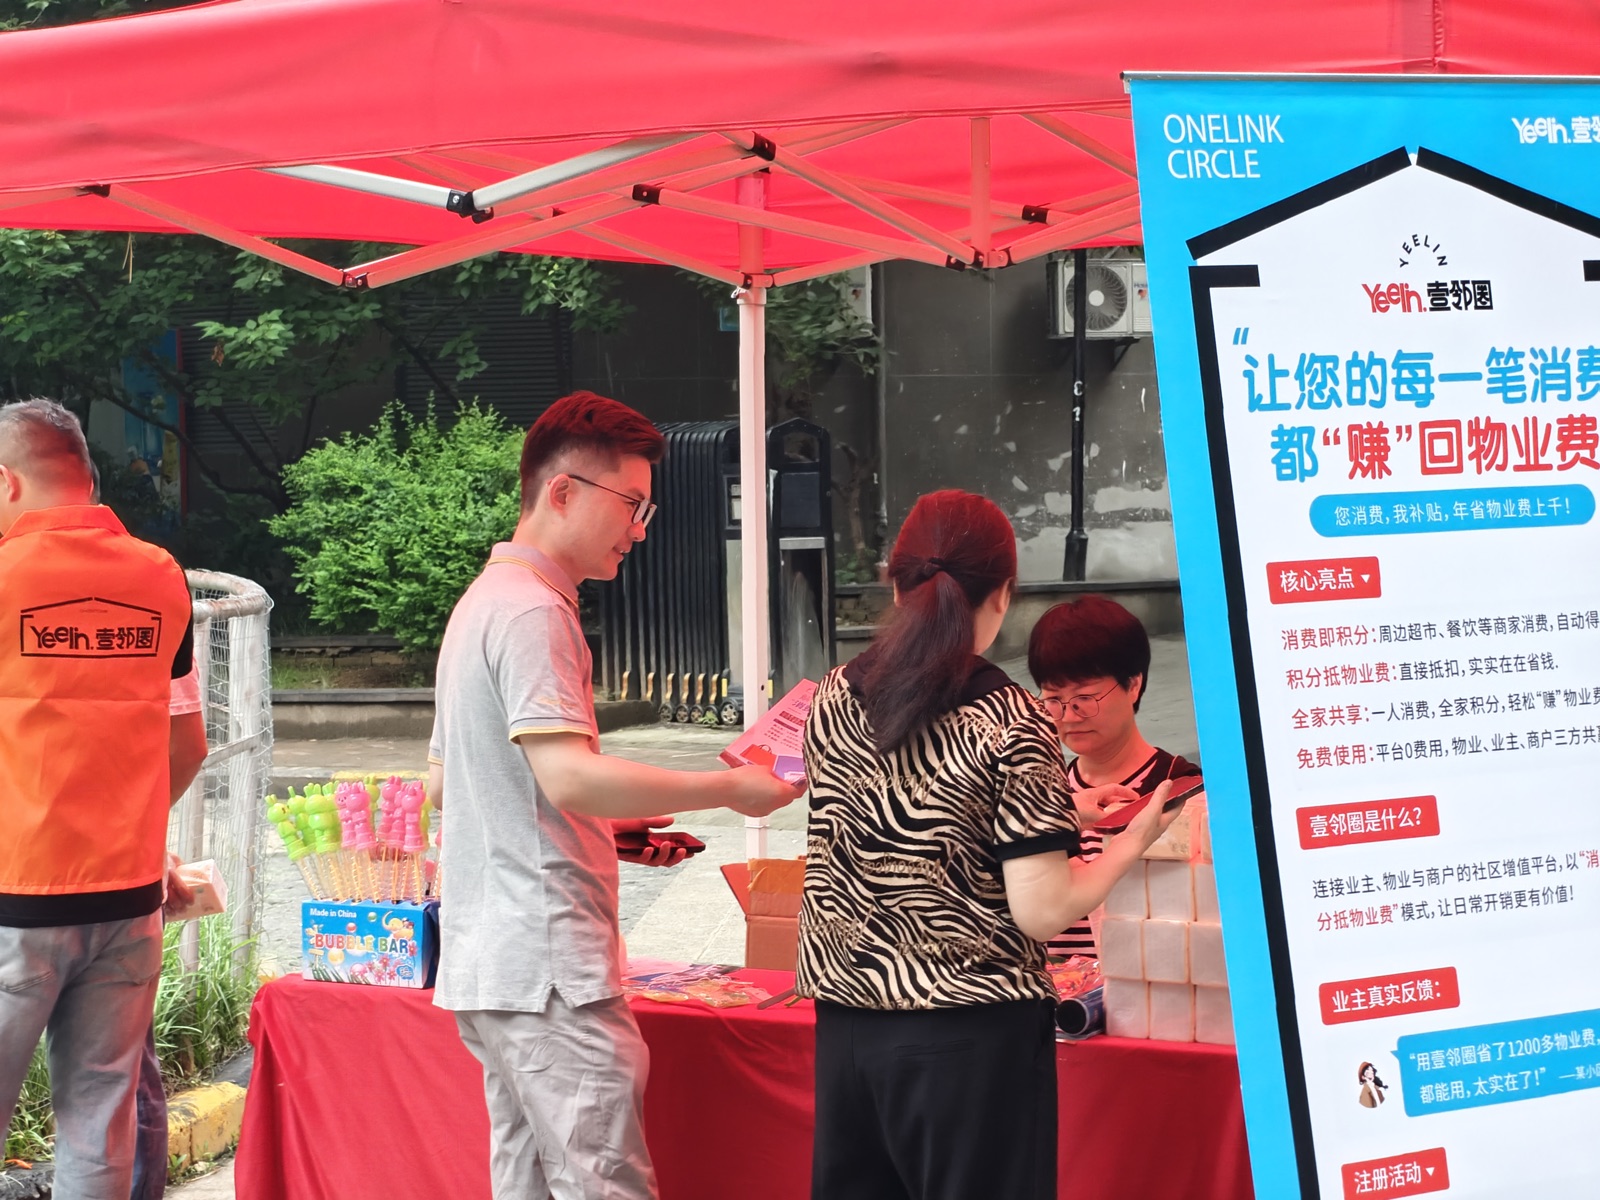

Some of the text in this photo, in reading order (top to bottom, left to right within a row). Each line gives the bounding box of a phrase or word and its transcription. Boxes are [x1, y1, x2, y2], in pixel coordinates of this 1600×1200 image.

[1163, 113, 1285, 144] ONELINK
[1167, 148, 1261, 179] CIRCLE
[1399, 233, 1448, 268] YEELIN
[1279, 566, 1356, 594] 核心亮点
[1309, 806, 1423, 838] 壹邻圈是什么？
[310, 908, 357, 918] Made in China
[314, 933, 409, 954] BUBBLE BAR
[1332, 979, 1441, 1014] 业主真实反馈：
[1353, 1161, 1422, 1194] 注册活动
